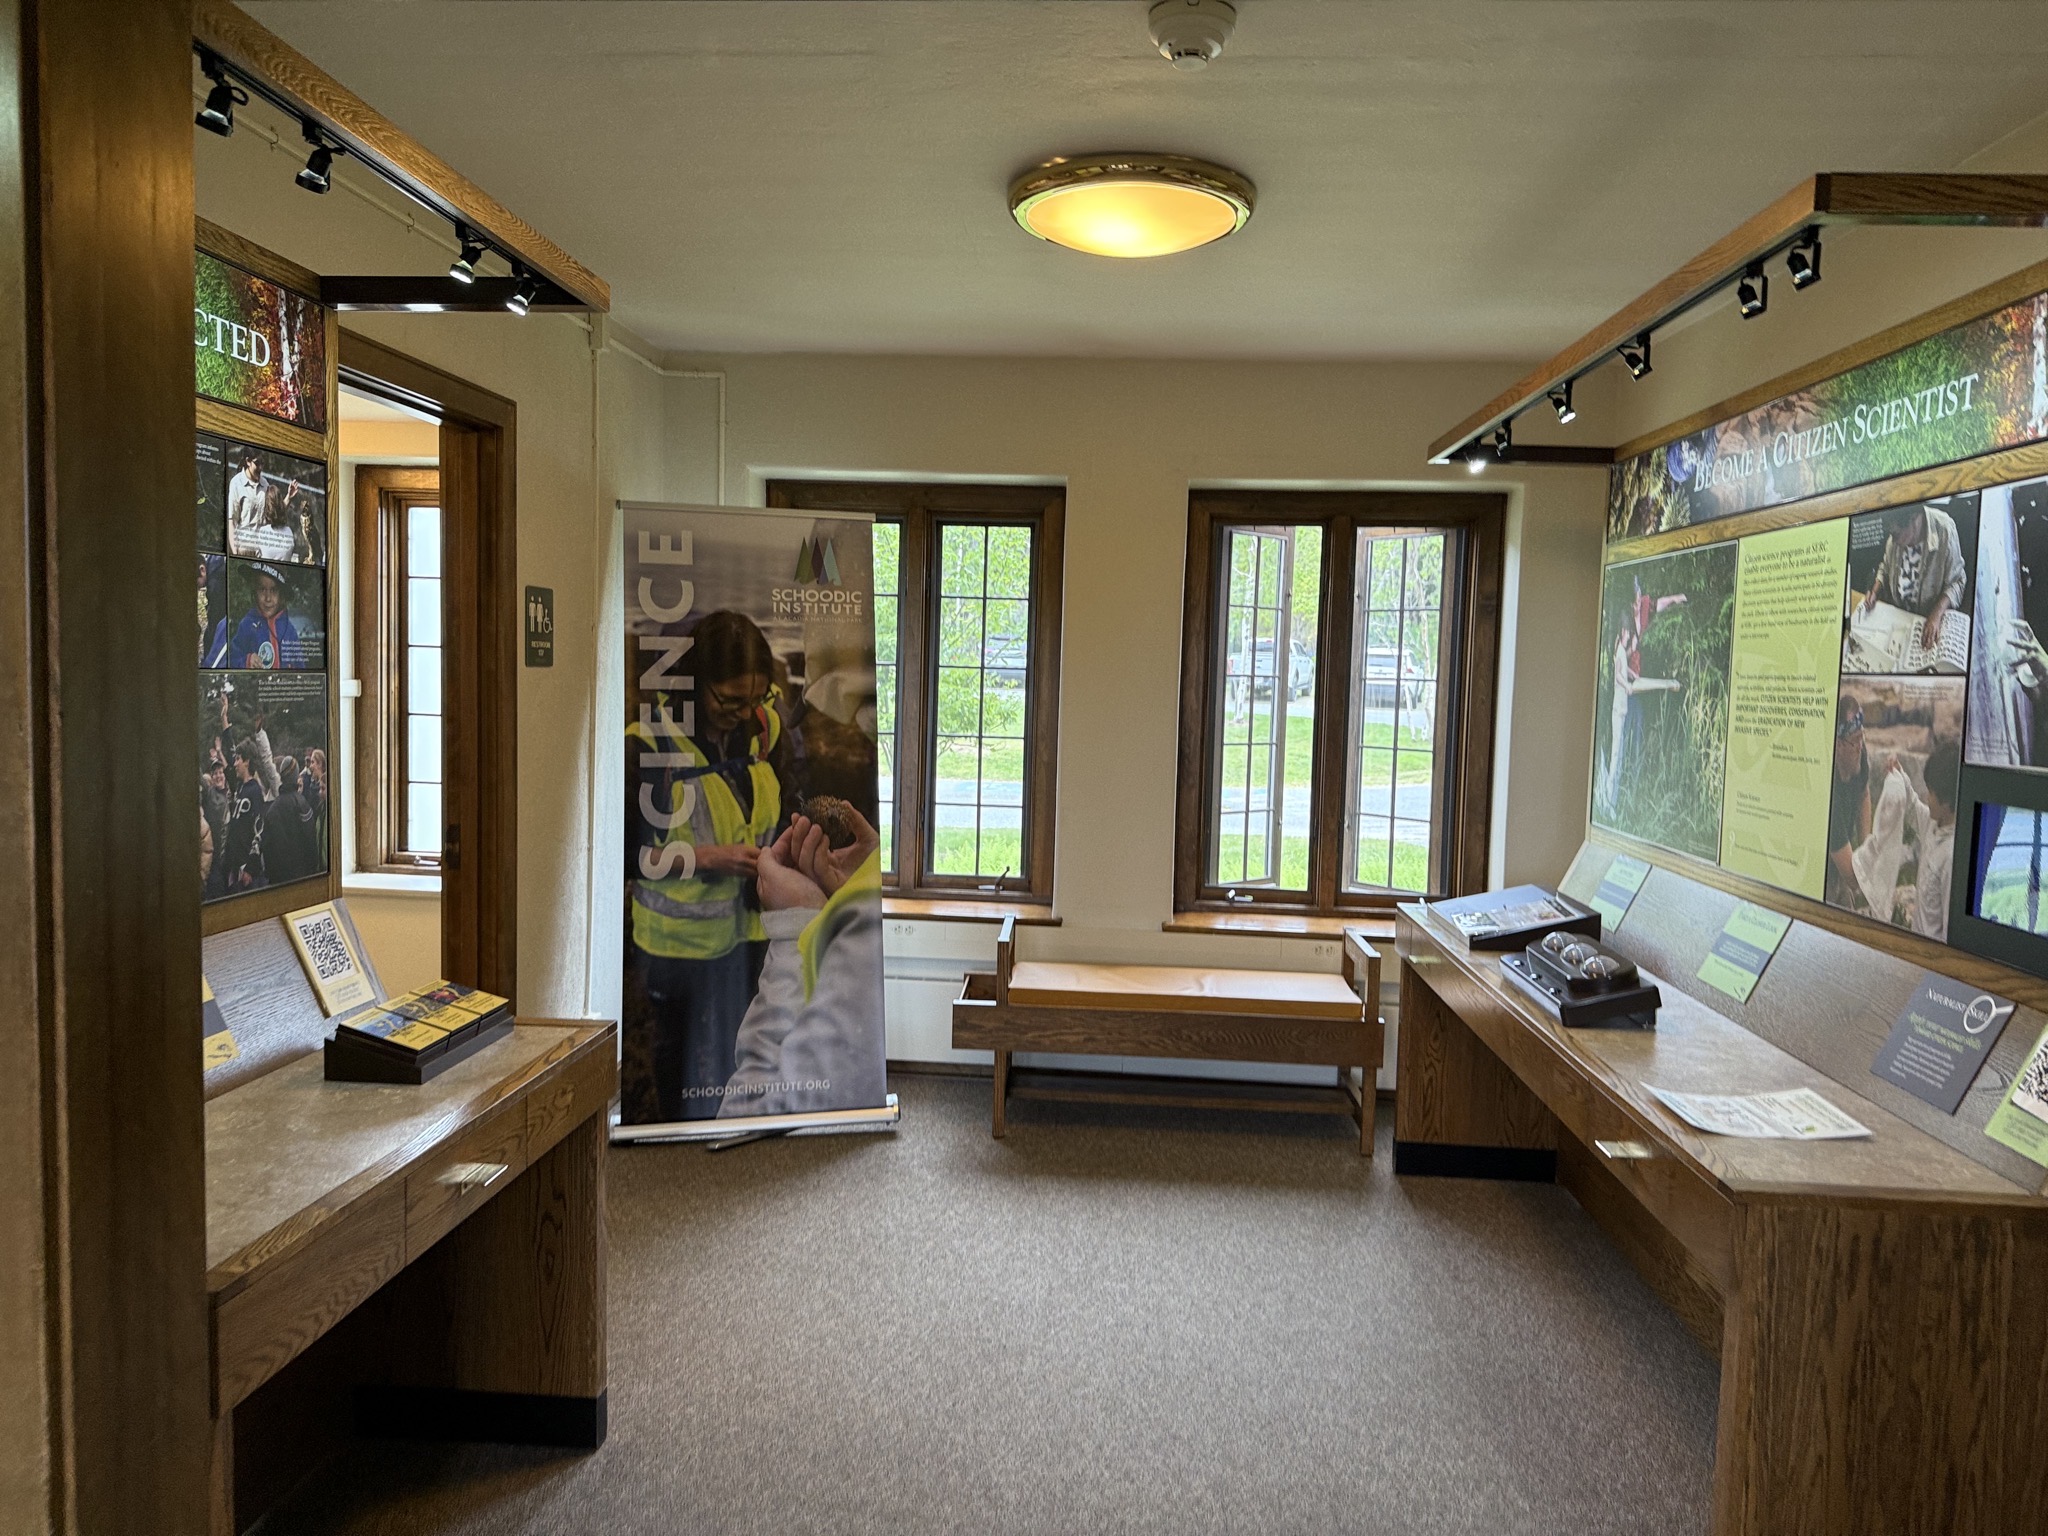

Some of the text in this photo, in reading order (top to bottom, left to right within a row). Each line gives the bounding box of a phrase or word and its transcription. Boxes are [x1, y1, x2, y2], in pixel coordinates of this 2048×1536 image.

[1694, 373, 1979, 492] BECOME A CITIZEN SCIENTIST
[772, 588, 862, 603] SCHOODIC
[773, 602, 862, 615] INSTITUTE
[638, 530, 696, 880] SCIENCE
[682, 1079, 831, 1099] SCHOODICINSTITUTE.ORG
